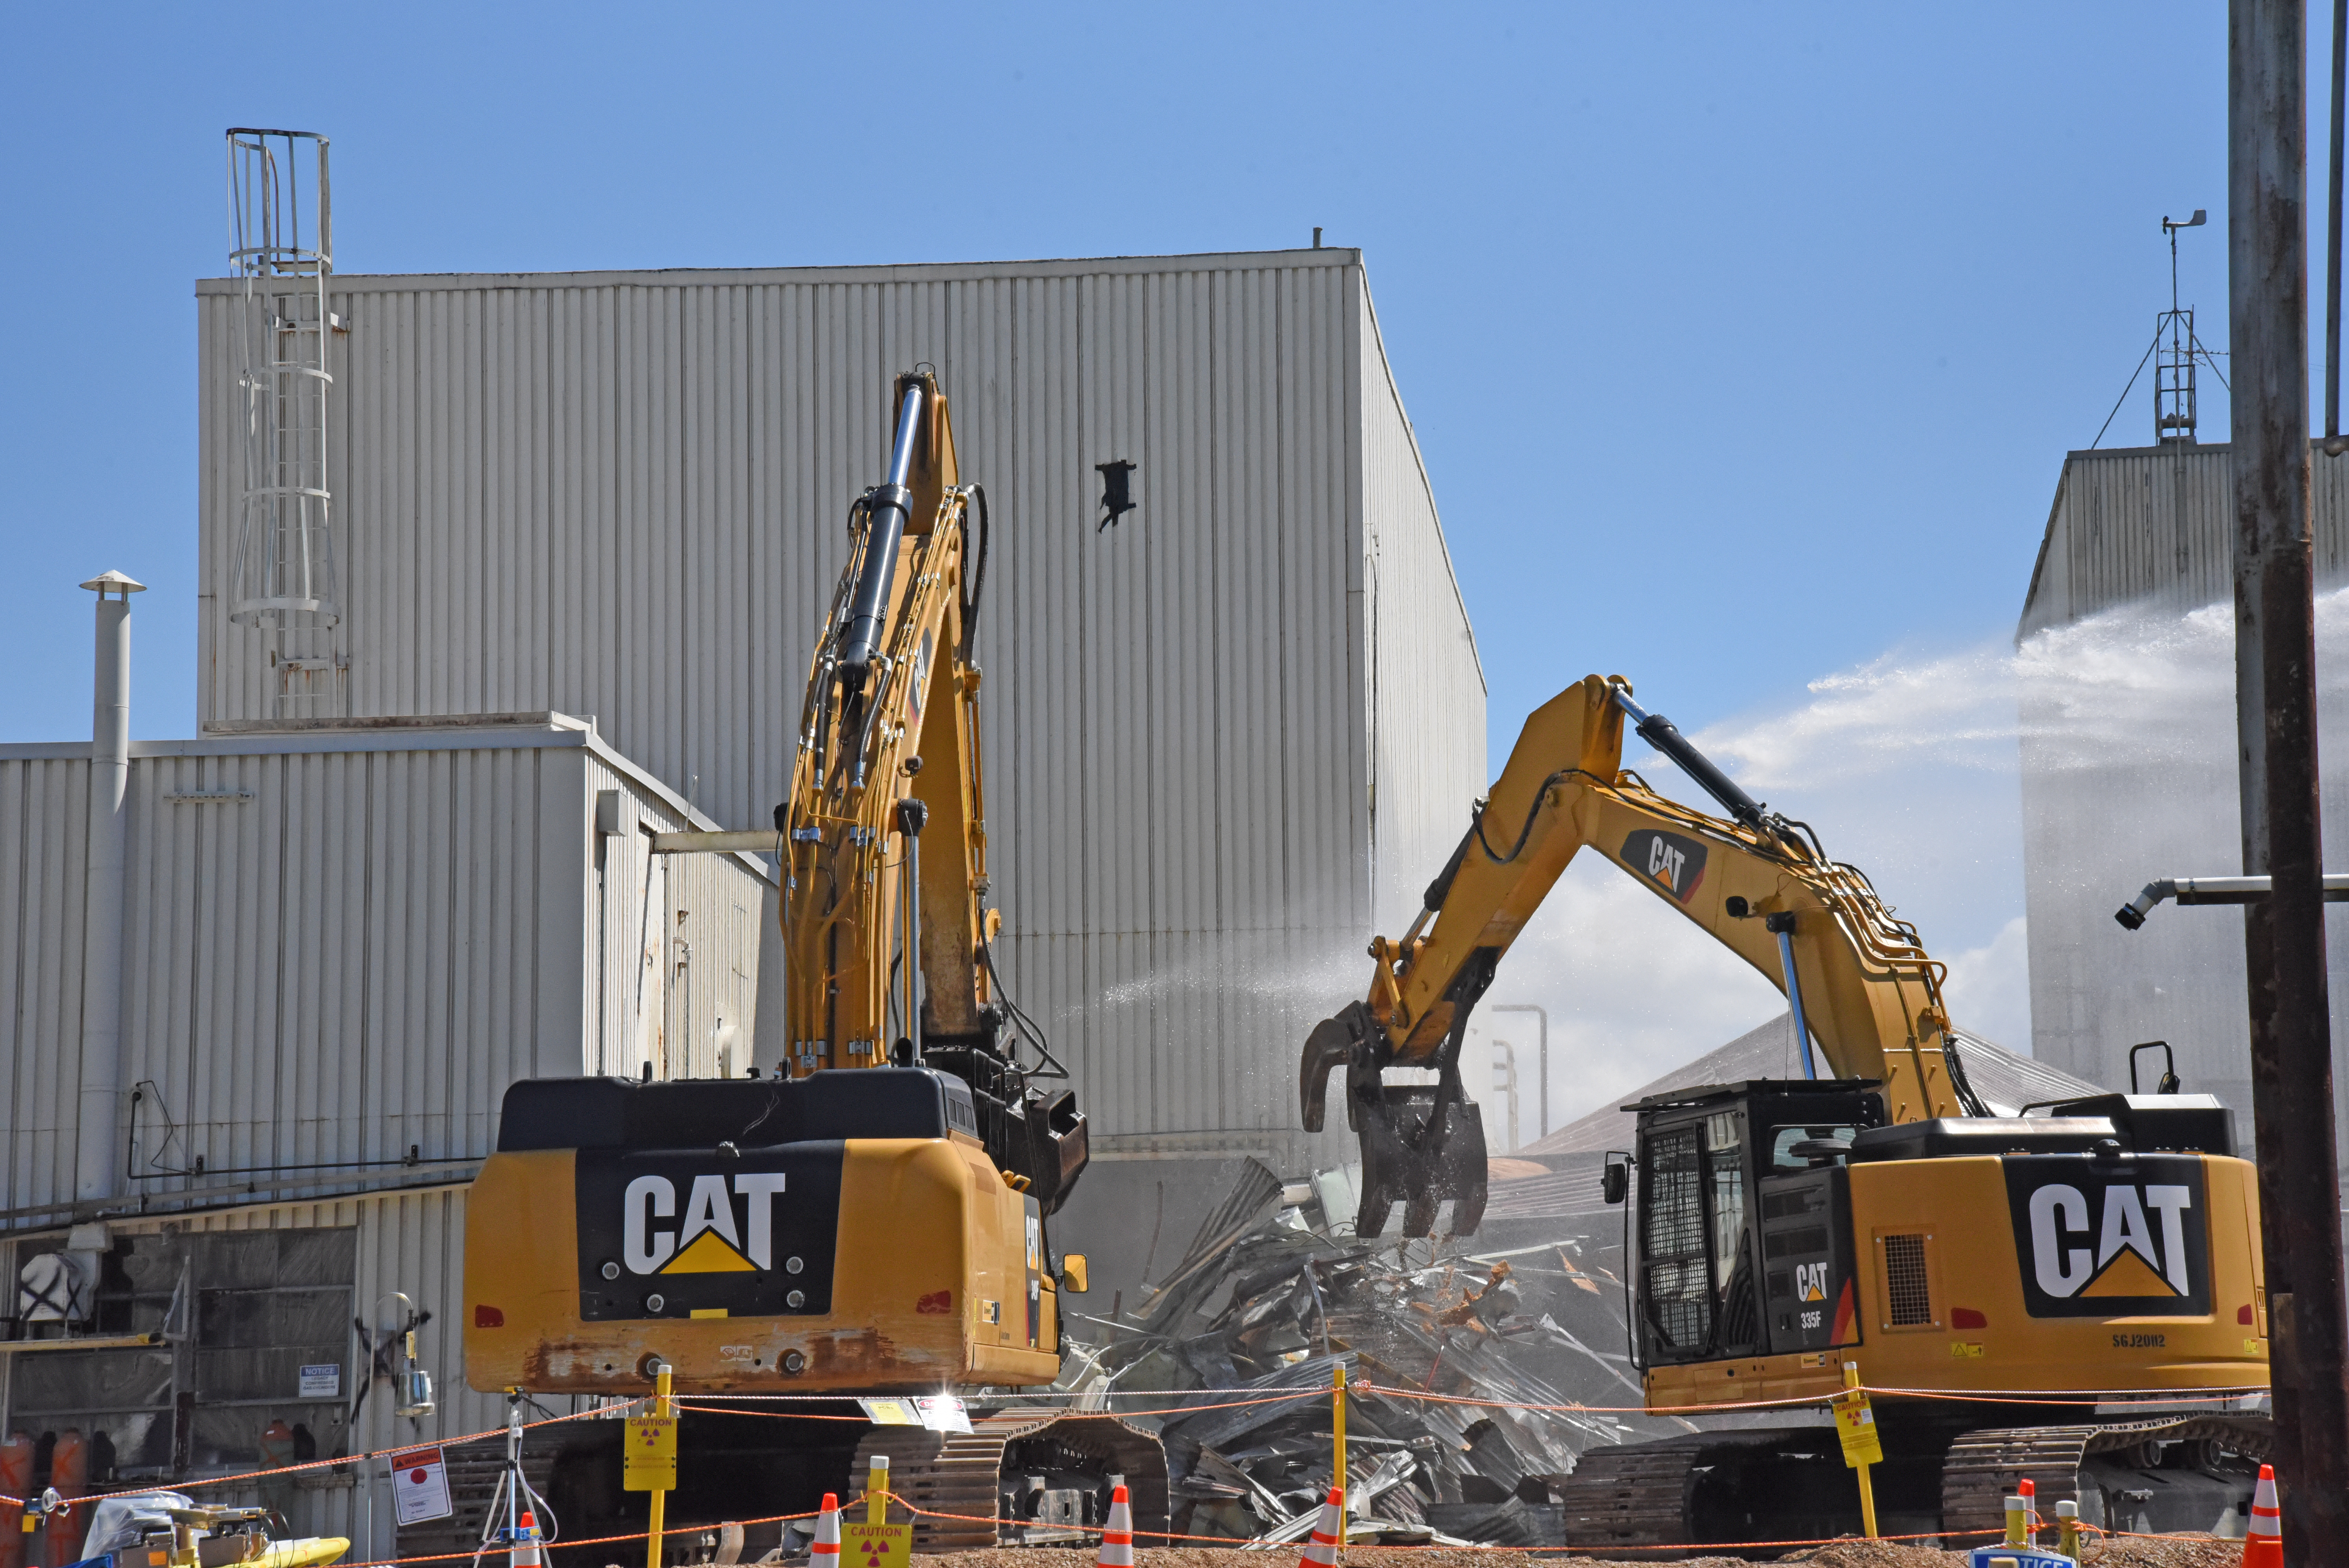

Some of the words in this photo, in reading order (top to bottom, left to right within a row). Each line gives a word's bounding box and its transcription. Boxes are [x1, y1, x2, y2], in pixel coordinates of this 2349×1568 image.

[1649, 836, 1685, 893] CAT
[624, 1173, 785, 1275] CAT
[1026, 1215, 1038, 1270] CAT
[2029, 1184, 2191, 1298] CAT
[1796, 1262, 1827, 1302] CAT
[1801, 1311, 1821, 1329] 335F
[1837, 1400, 1866, 1411] CAUTION
[404, 1452, 439, 1465] WARNING
[851, 1527, 902, 1537] CAUTION
